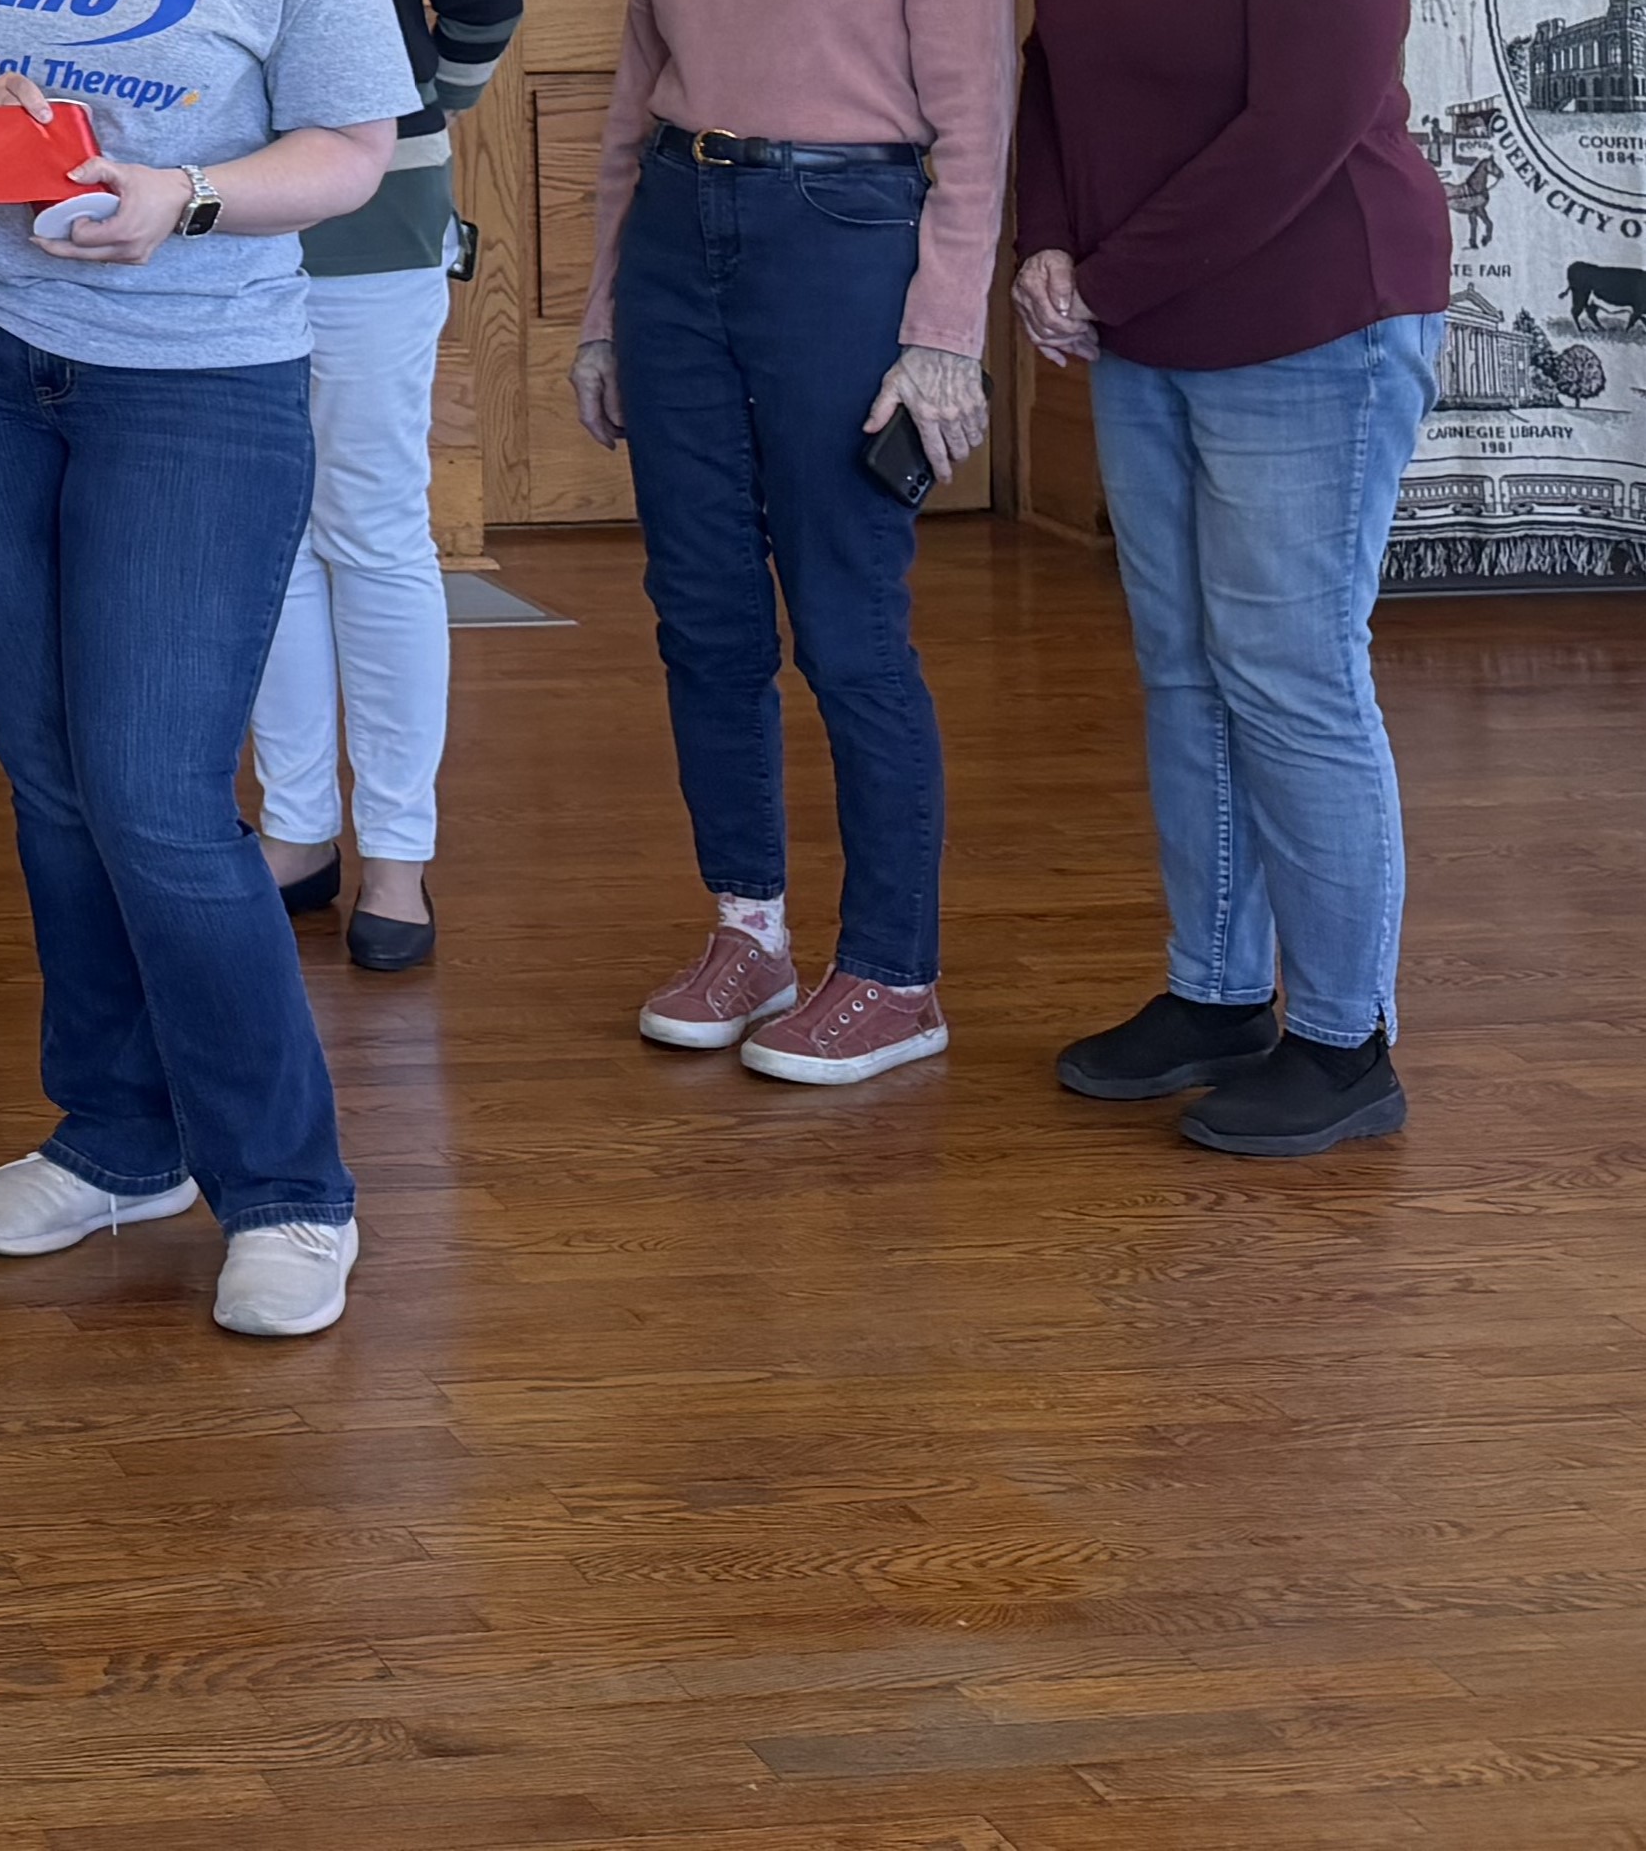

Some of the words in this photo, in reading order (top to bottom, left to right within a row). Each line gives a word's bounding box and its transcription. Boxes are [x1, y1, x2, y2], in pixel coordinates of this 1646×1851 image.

[43, 58, 188, 112] Therapy
[1490, 113, 1551, 195] QUEEN
[1546, 189, 1615, 234] CITY
[1479, 264, 1512, 278] FAIR
[1426, 425, 1505, 441] CARNEGIE
[1510, 425, 1574, 440] LIBRARY
